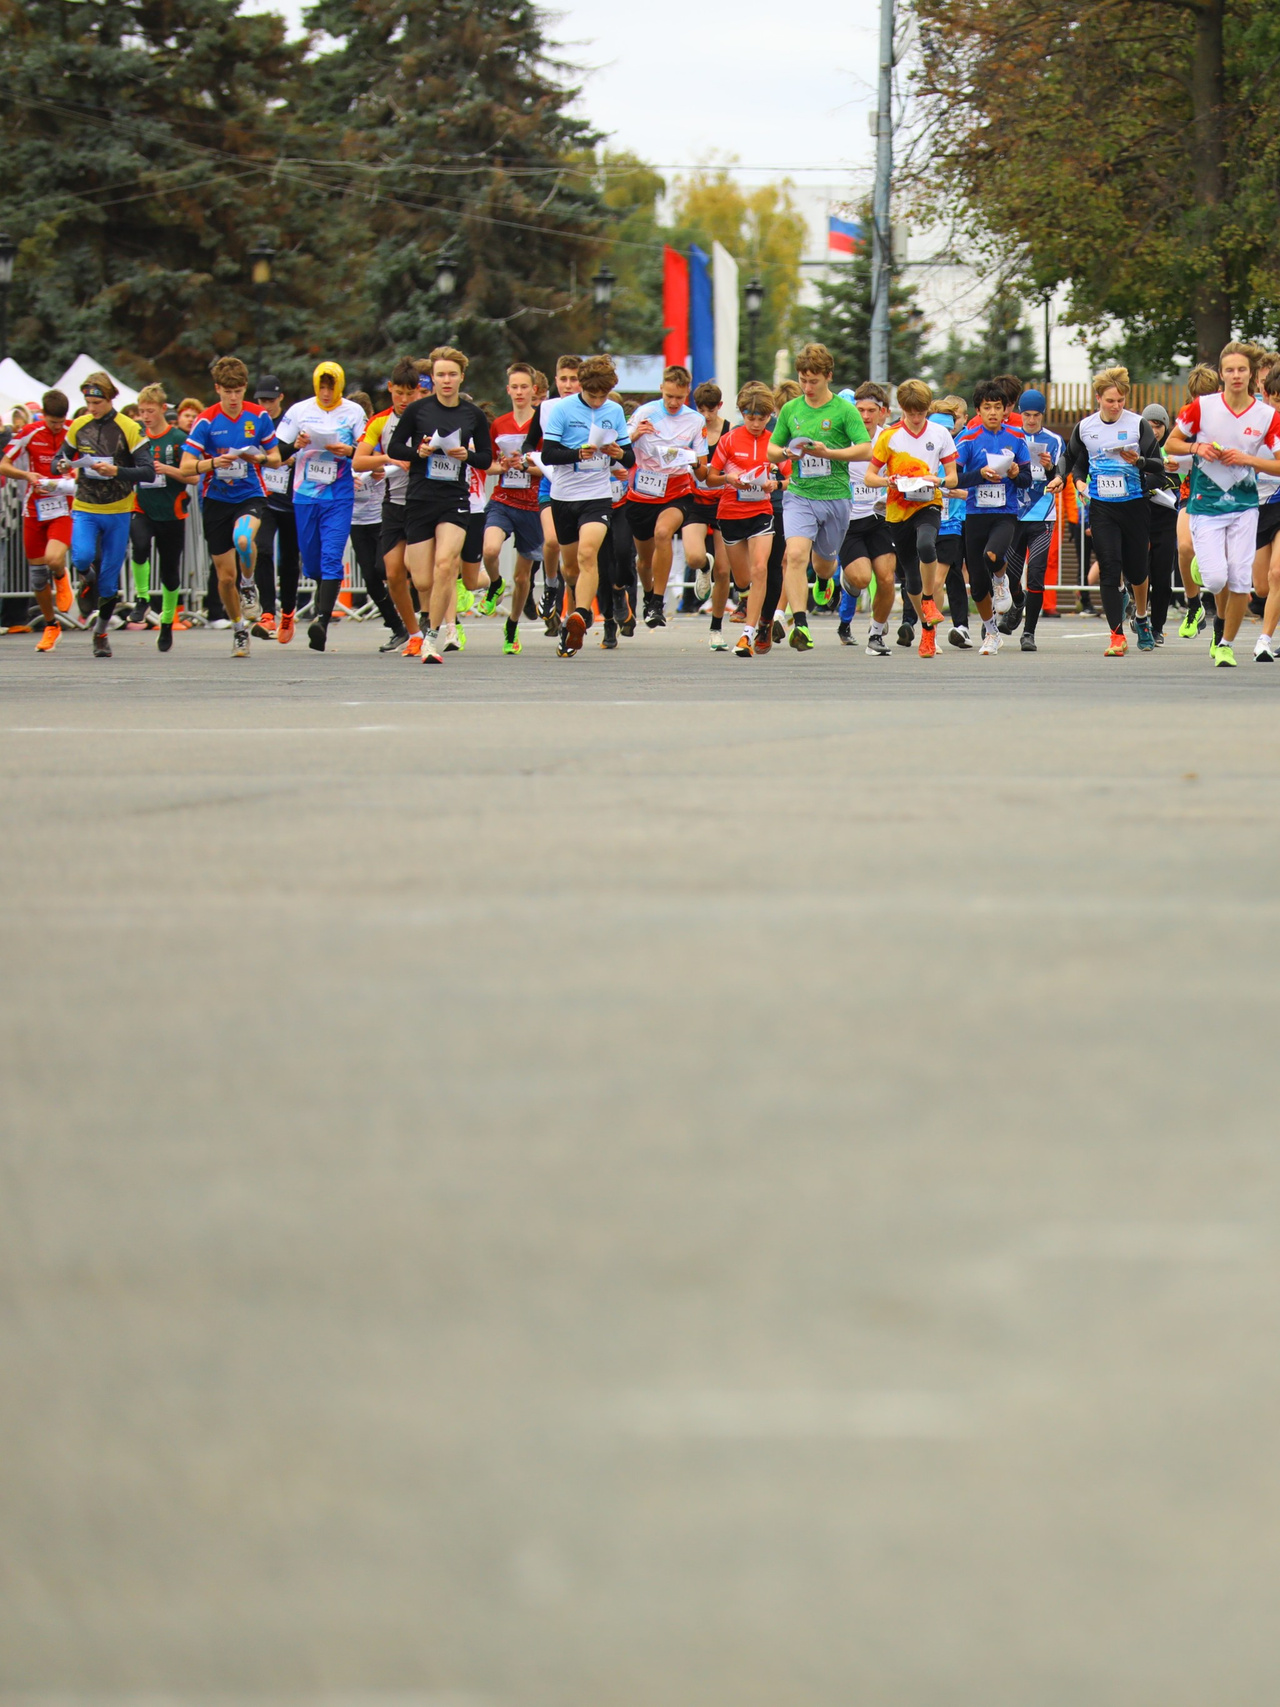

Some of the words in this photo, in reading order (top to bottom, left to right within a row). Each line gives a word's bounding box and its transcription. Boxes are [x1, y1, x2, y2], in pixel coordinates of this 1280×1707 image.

[308, 464, 332, 475] 304.1
[432, 460, 456, 471] 308.1
[264, 473, 283, 484] 303.1
[638, 476, 662, 487] 327.1
[1101, 480, 1123, 488] 333.1
[978, 490, 1000, 499] 354.1
[40, 502, 63, 513] 322.1
